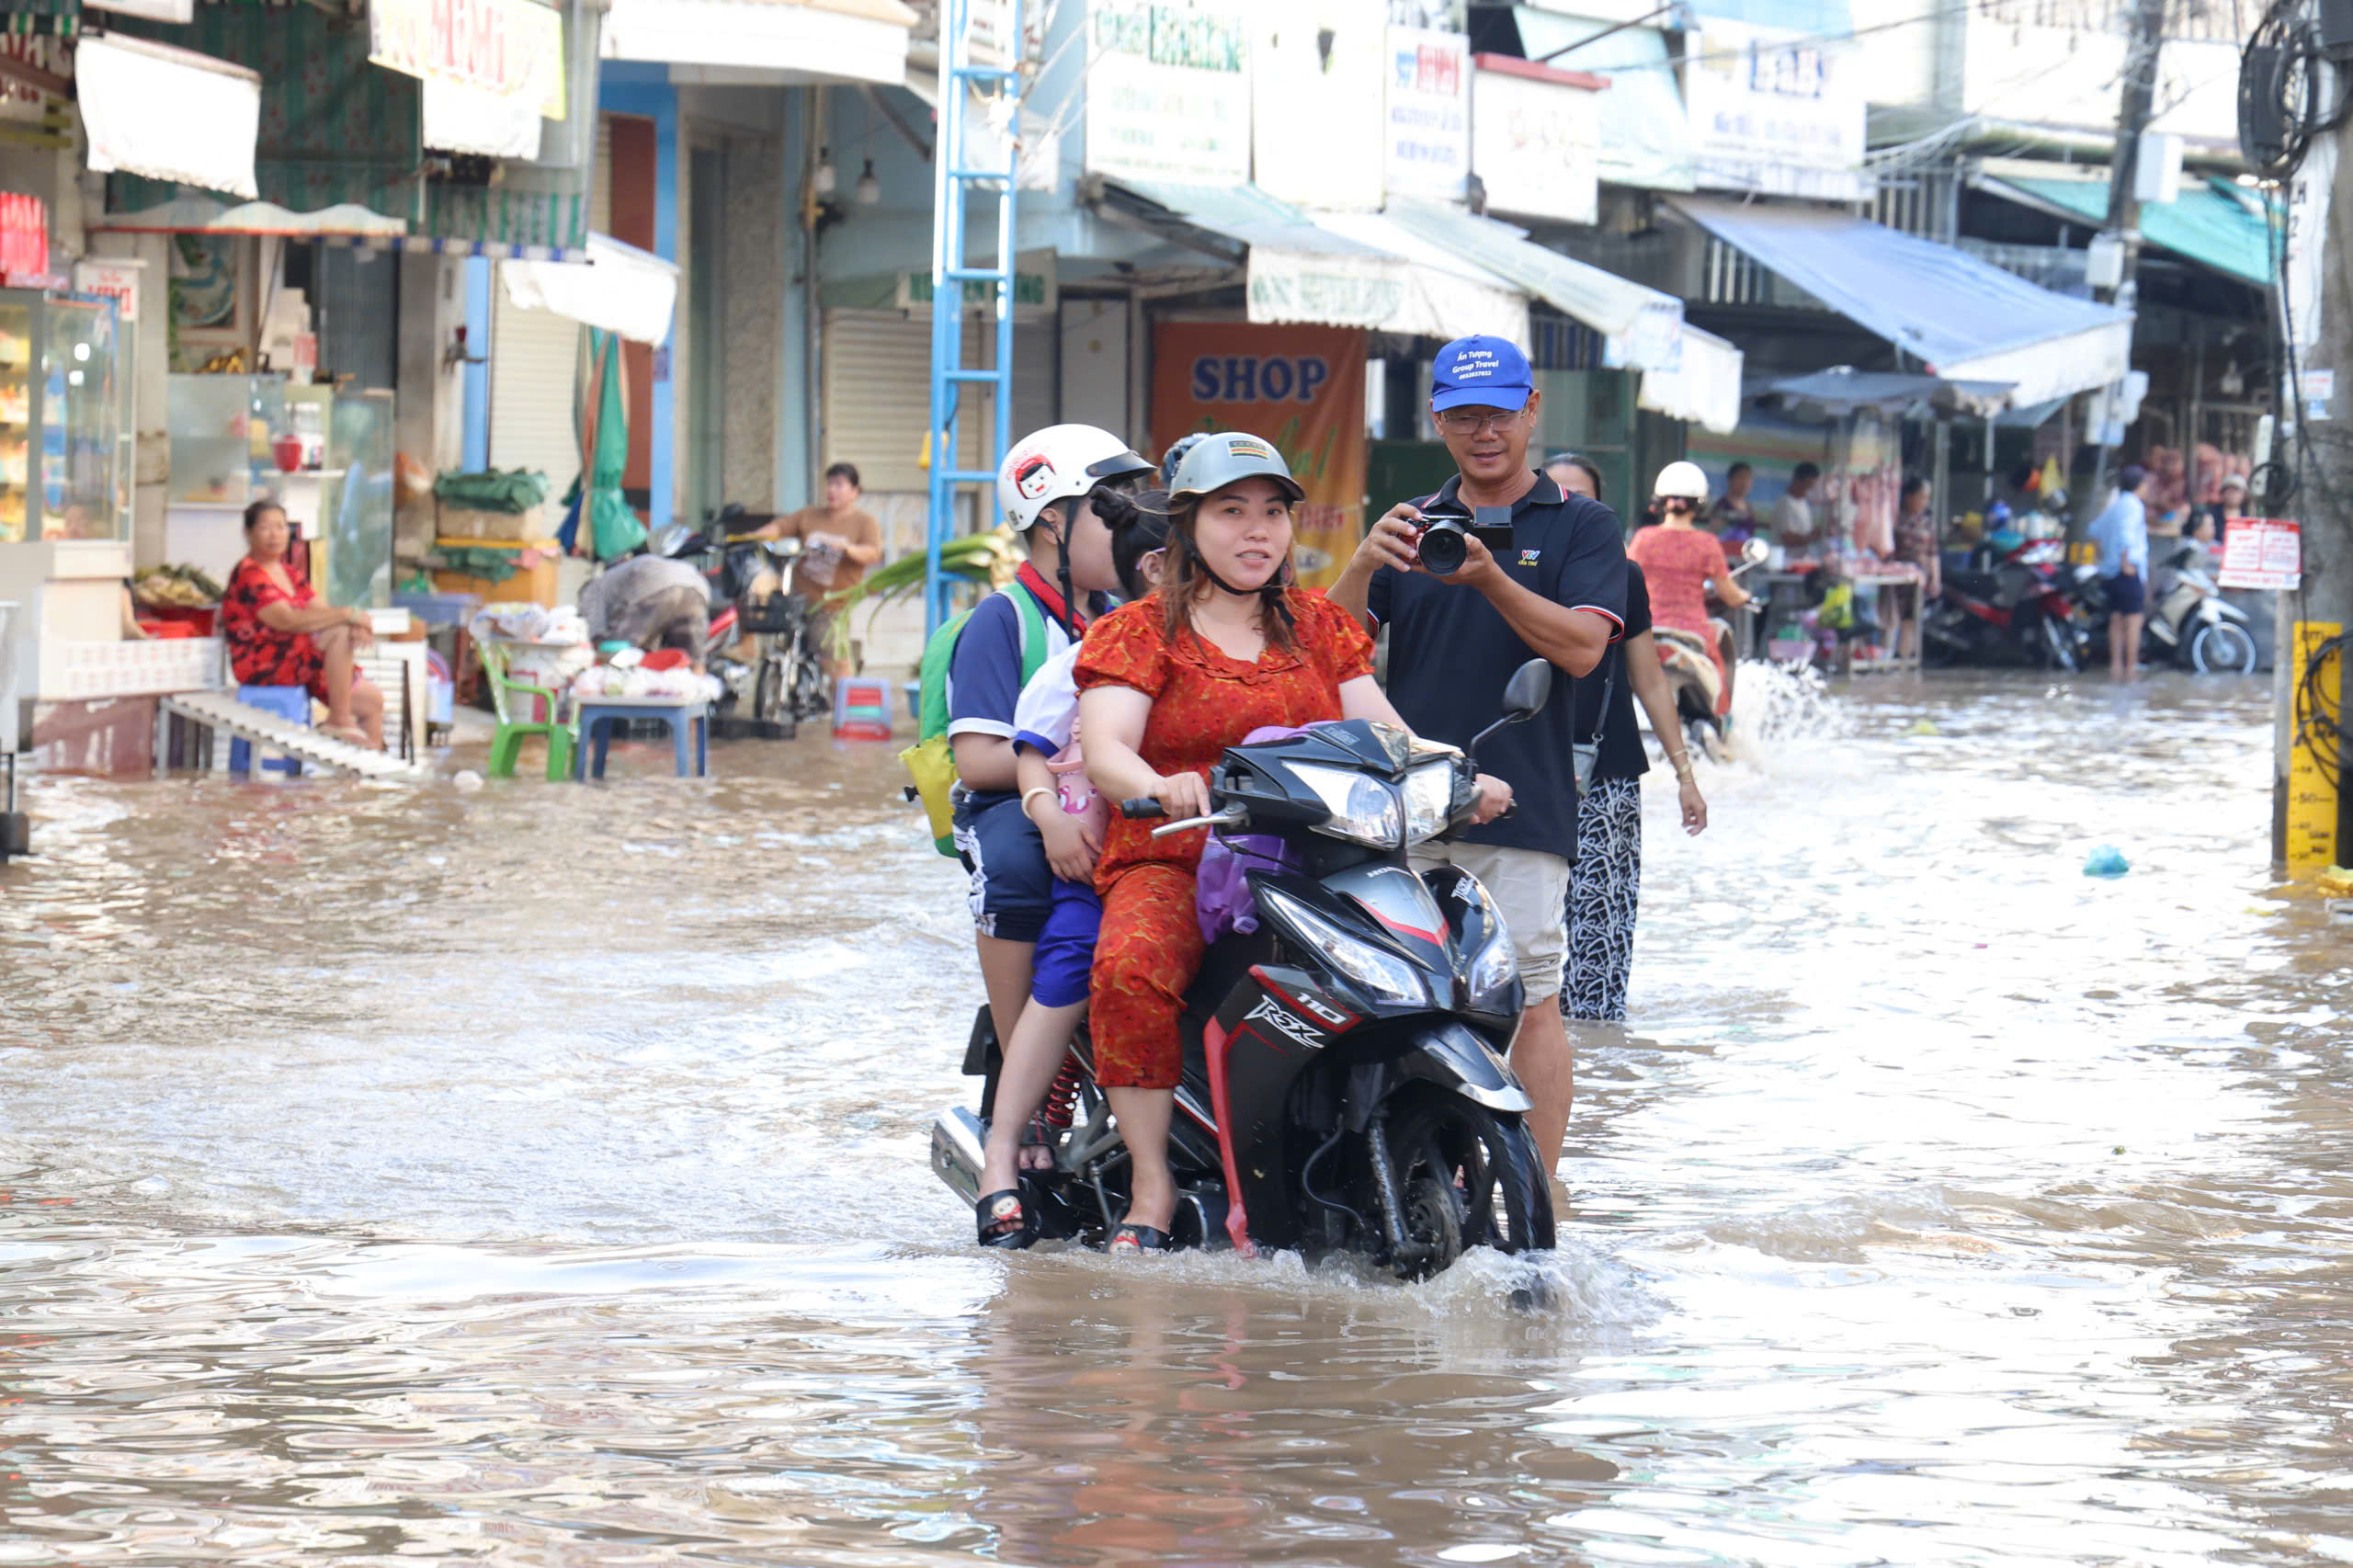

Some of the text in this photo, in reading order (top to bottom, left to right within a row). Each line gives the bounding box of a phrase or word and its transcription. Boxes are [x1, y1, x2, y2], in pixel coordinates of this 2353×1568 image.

[1452, 359, 1499, 373] Group Travel
[1191, 356, 1327, 403] SHOP
[1521, 550, 1541, 560] VTV
[1296, 992, 1347, 1025] 110
